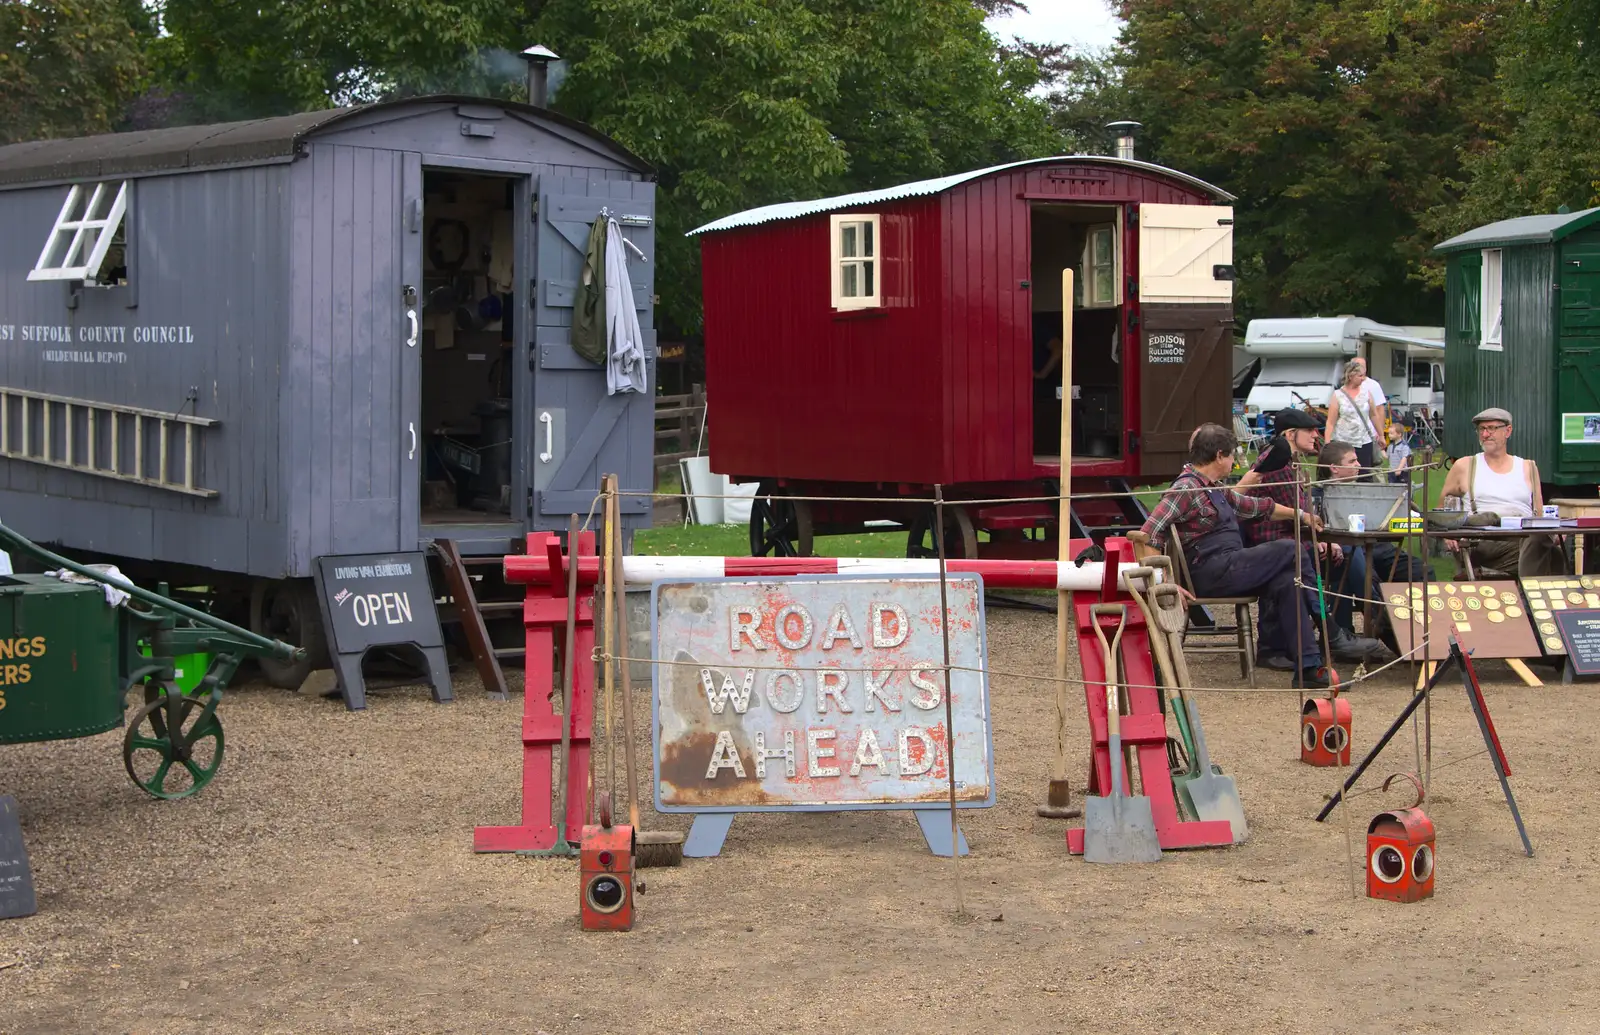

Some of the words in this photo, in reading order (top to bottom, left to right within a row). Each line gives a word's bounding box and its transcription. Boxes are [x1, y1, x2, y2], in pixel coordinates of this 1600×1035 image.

[22, 326, 72, 342] SUFFOLK
[79, 326, 126, 343] COUNTY
[133, 326, 194, 344] COUNCIL
[1149, 335, 1185, 346] EDDISON
[335, 567, 359, 579] LIVING
[353, 592, 413, 627] OPEN
[730, 602, 908, 651] ROAD
[700, 661, 943, 715] WORKS
[705, 727, 937, 779] AHEAD
